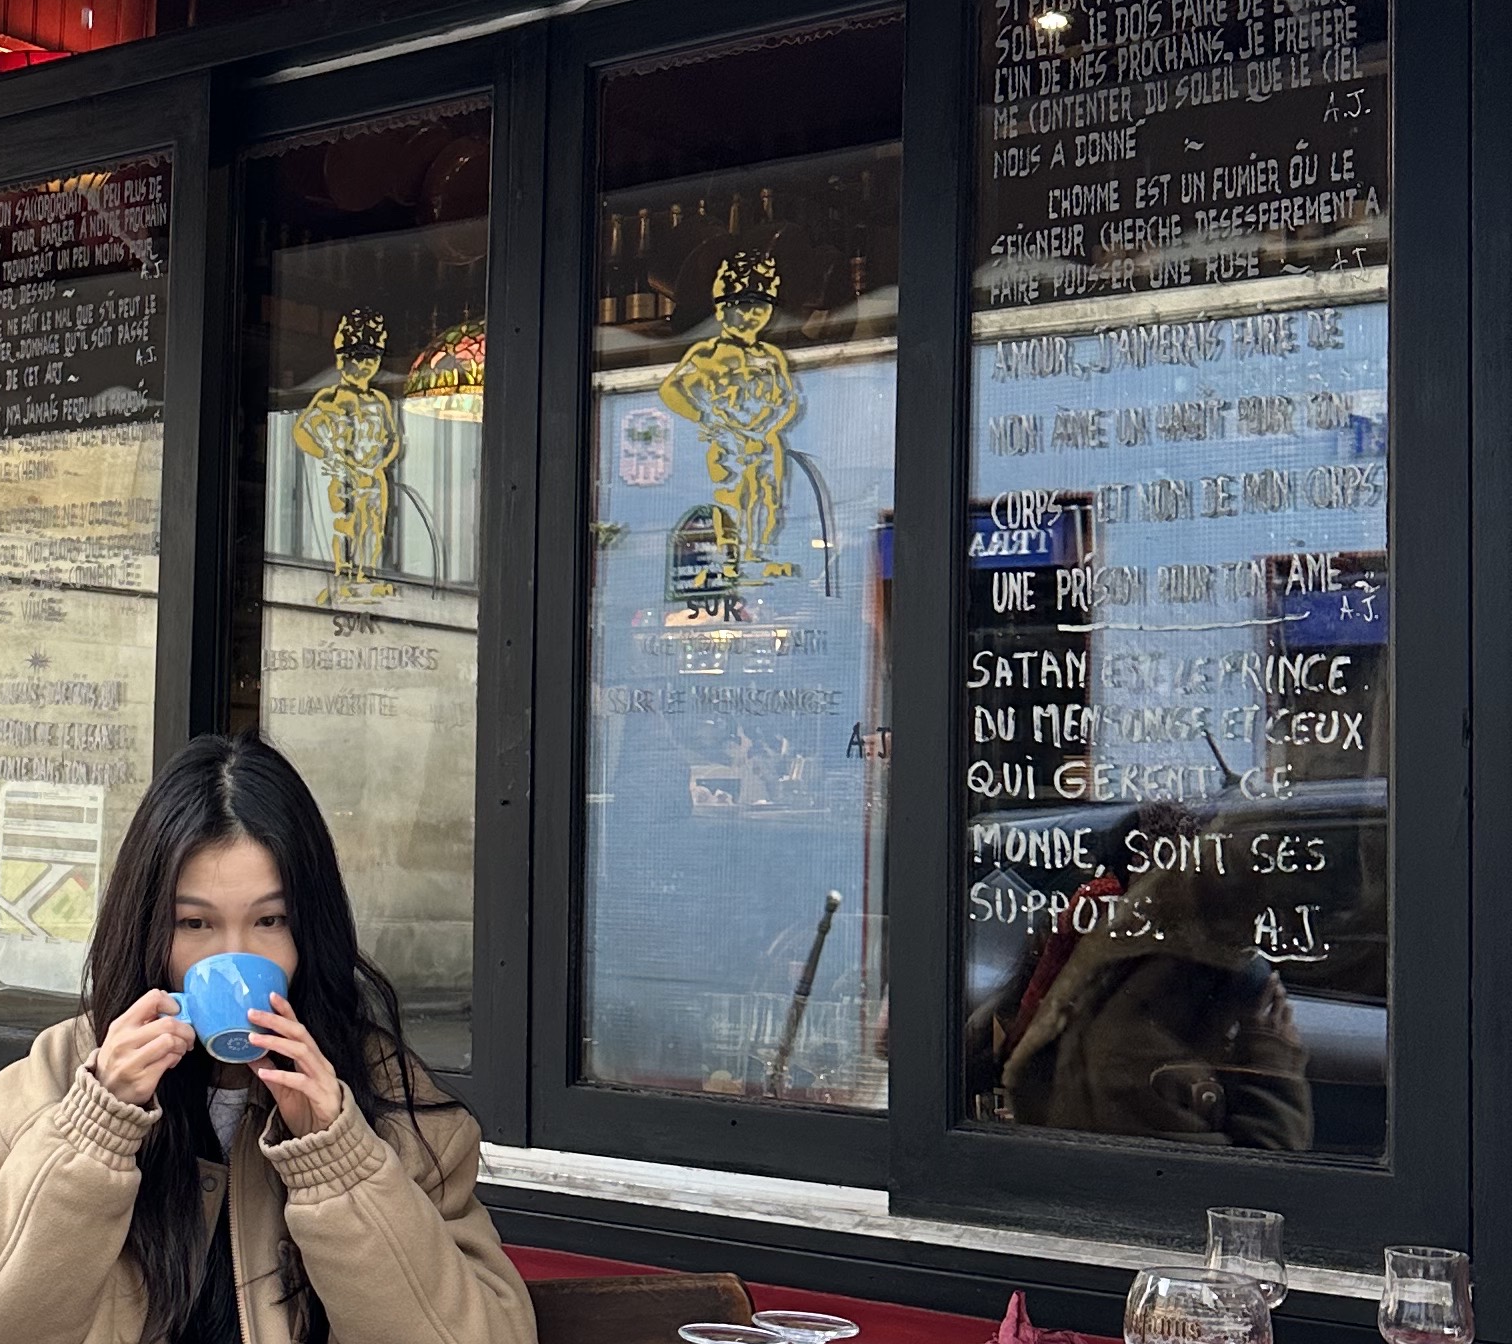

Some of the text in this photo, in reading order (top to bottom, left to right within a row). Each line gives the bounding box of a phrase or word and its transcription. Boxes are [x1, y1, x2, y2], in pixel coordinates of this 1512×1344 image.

[1081, 7, 1108, 52] JE
[994, 64, 1032, 104] L'UN
[1039, 58, 1061, 96] DE
[1069, 50, 1108, 91] MES
[1239, 18, 1265, 59] JE
[994, 42, 1364, 141] ME CONTENTER DU SOLEIL QUE LE CIEL
[994, 119, 1147, 179] NOUS A DONNÉ
[103, 181, 121, 209] PEU
[124, 177, 147, 204] PLUS
[148, 175, 163, 200] DE
[1048, 179, 1120, 220] L'HOMME
[1135, 174, 1172, 209] EST
[1181, 170, 1205, 204] UN
[1212, 153, 1282, 201] FUMIER
[1331, 148, 1355, 182] LE
[12, 228, 39, 254] POUR
[57, 248, 70, 271] UN
[72, 246, 91, 268] PEU
[991, 222, 1086, 265] SEIGNEUR
[1100, 213, 1183, 254] CHERCHE
[20, 279, 56, 306] DESSUS
[990, 250, 1260, 305] FAIRE POUSSER UNE ROSE
[21, 308, 39, 334] FAIT
[41, 310, 53, 331] LE
[55, 307, 72, 329] MAL
[75, 304, 94, 330] QUE
[118, 295, 141, 319] PEUT
[145, 294, 157, 315] LE
[5, 369, 19, 391] DE
[24, 365, 40, 388] CET
[44, 361, 64, 386] ART
[991, 489, 1063, 532] CORPS
[992, 571, 1036, 613] UNE
[1056, 552, 1148, 612] PRISON
[688, 596, 746, 622] SUR
[966, 649, 1088, 689] SATAN
[974, 703, 1364, 750] DU MENSONGE ET CEUX
[966, 755, 1036, 799] QUI
[1239, 764, 1293, 801] CE
[973, 822, 1327, 879] MONDE, SONT SES
[1254, 906, 1330, 952] A.J.
